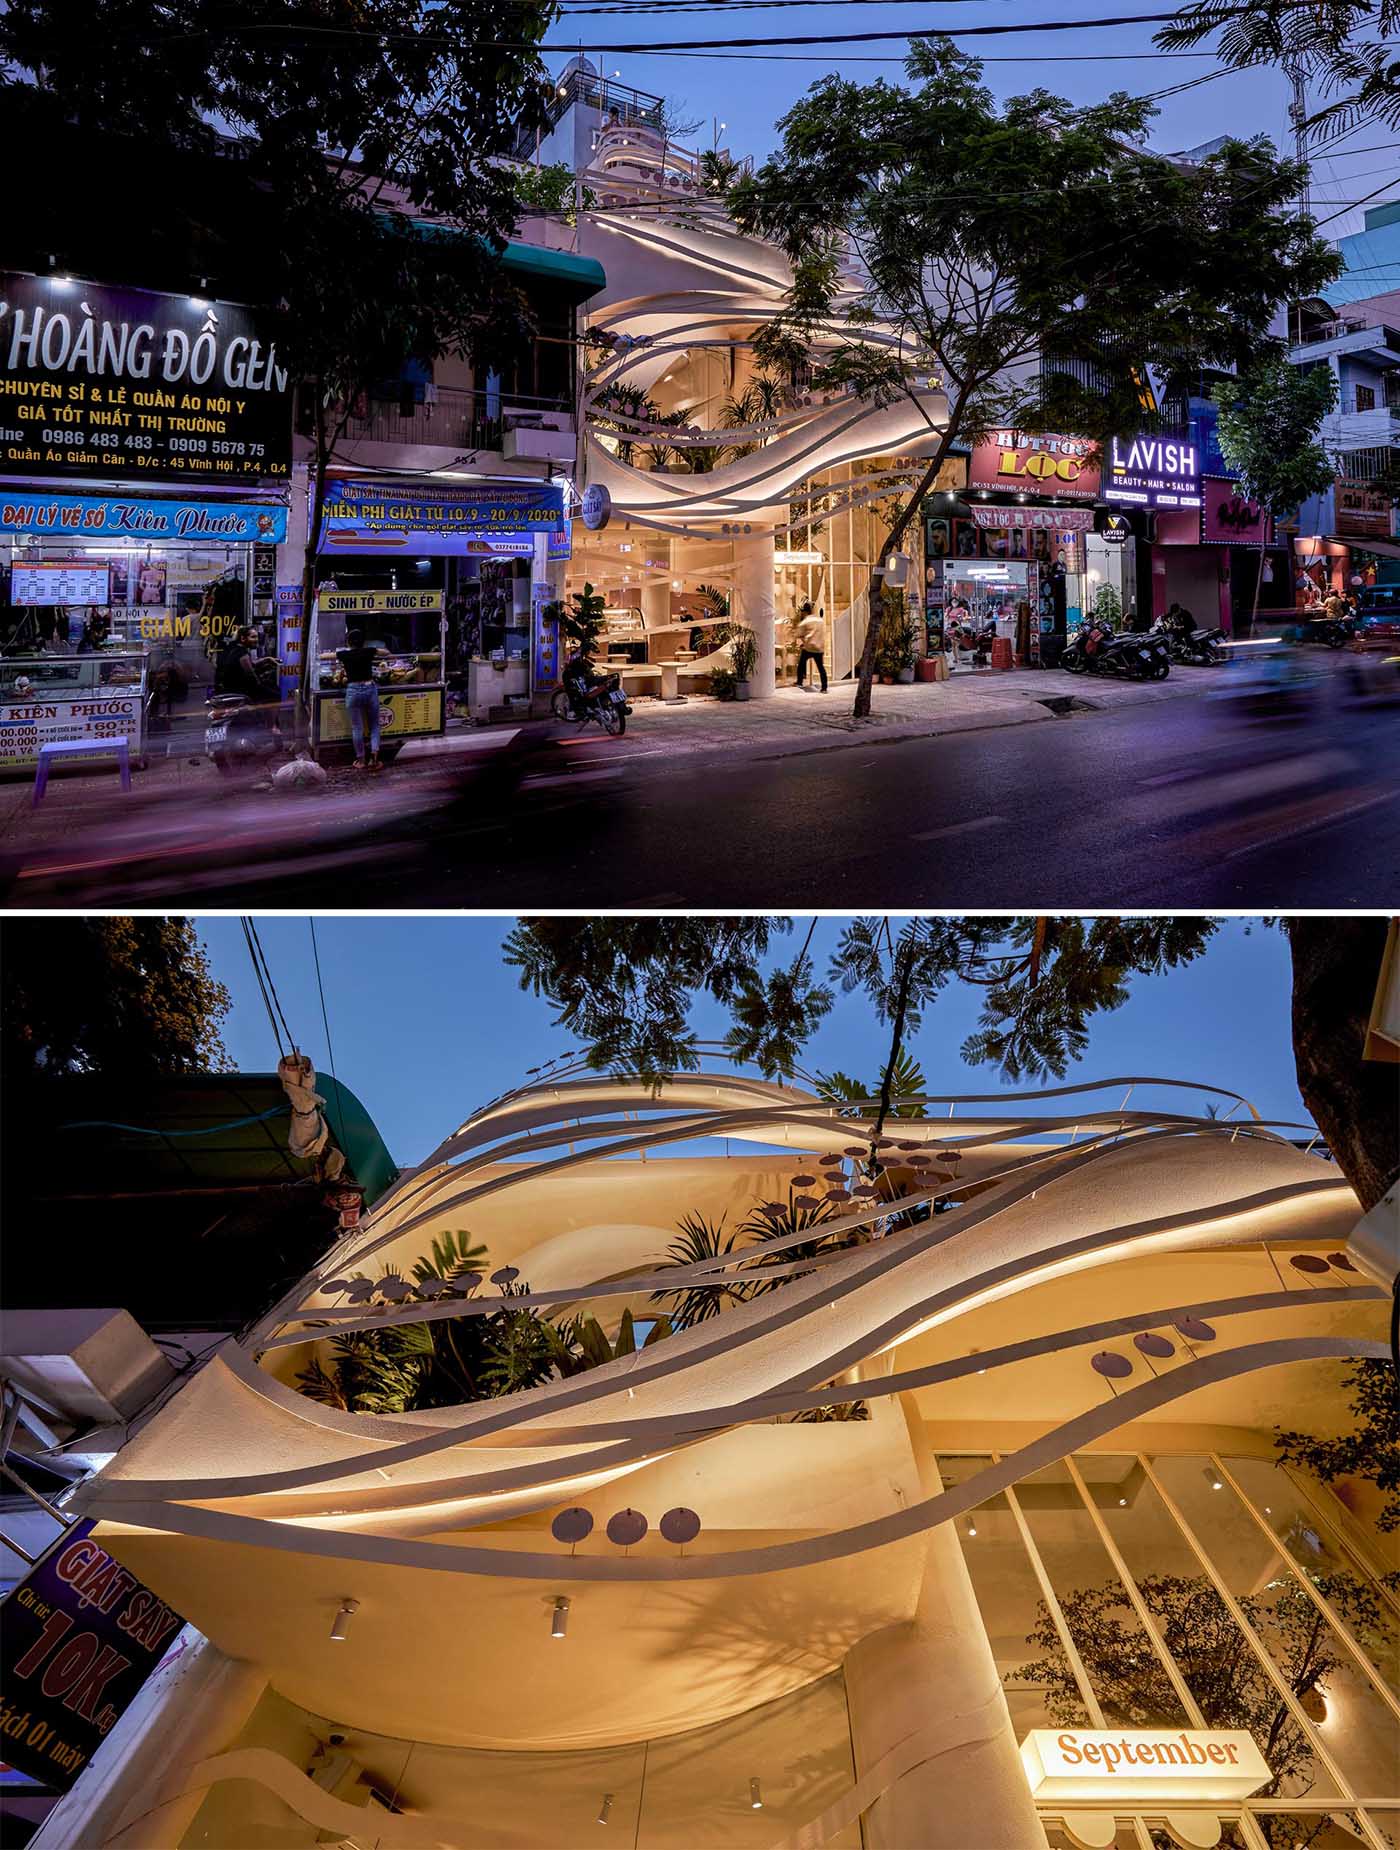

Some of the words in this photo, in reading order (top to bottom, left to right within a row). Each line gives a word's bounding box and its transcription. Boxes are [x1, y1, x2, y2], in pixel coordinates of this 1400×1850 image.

[8, 301, 154, 379] HOÀNG
[162, 309, 217, 385] ĐỒ
[0, 380, 62, 399] CHUYÊN
[68, 383, 85, 400] SỈ
[91, 388, 102, 402] &
[108, 386, 127, 404] LẺ
[133, 389, 175, 408] QUẦN
[181, 394, 201, 410] ÁO
[206, 397, 231, 414] NỘI
[236, 401, 246, 414] Y
[17, 404, 47, 421] GIÁ
[52, 404, 84, 423] TỐT
[89, 408, 132, 426] NHẤT
[137, 414, 163, 431] THỊ
[168, 416, 226, 433] TRƯỜNG
[42, 429, 84, 445] 0986
[90, 433, 119, 447] 483
[124, 435, 152, 449] 483
[169, 438, 207, 452] 0909
[212, 441, 245, 455] 5678
[249, 443, 265, 456] 75
[1113, 436, 1194, 476] LAVISH
[46, 449, 62, 462] Áo
[67, 451, 98, 464] Giảm
[102, 454, 125, 465] Cân
[170, 458, 185, 468] 45
[189, 458, 212, 470] Vĩnh
[216, 460, 233, 472] Hội
[244, 461, 261, 472] P.4
[997, 449, 1082, 482] LỘC
[1113, 476, 1141, 486] BEAUTY
[1148, 480, 1164, 489] HAIR
[1172, 482, 1195, 492] SALON
[2, 504, 34, 529] ĐẠI
[37, 503, 58, 526] LÝ
[84, 503, 108, 529] SỐ
[109, 505, 169, 531] Kiên
[361, 504, 385, 519] PHÍ
[328, 597, 356, 610] SINH
[360, 593, 374, 608] TỐ
[386, 594, 416, 608] NƯỚC
[420, 594, 434, 607] ÉP
[199, 615, 237, 637] 30%
[9, 704, 57, 719] KIÊN
[70, 700, 133, 717] PHƯỚC
[17, 1587, 40, 1608] Chỉ
[55, 1538, 137, 1615] GIẶT
[117, 1589, 179, 1652] SẤY
[14, 1609, 132, 1723] 10K
[26, 1720, 57, 1753] 01
[49, 1742, 86, 1775] máy
[1057, 1734, 1240, 1773] September
